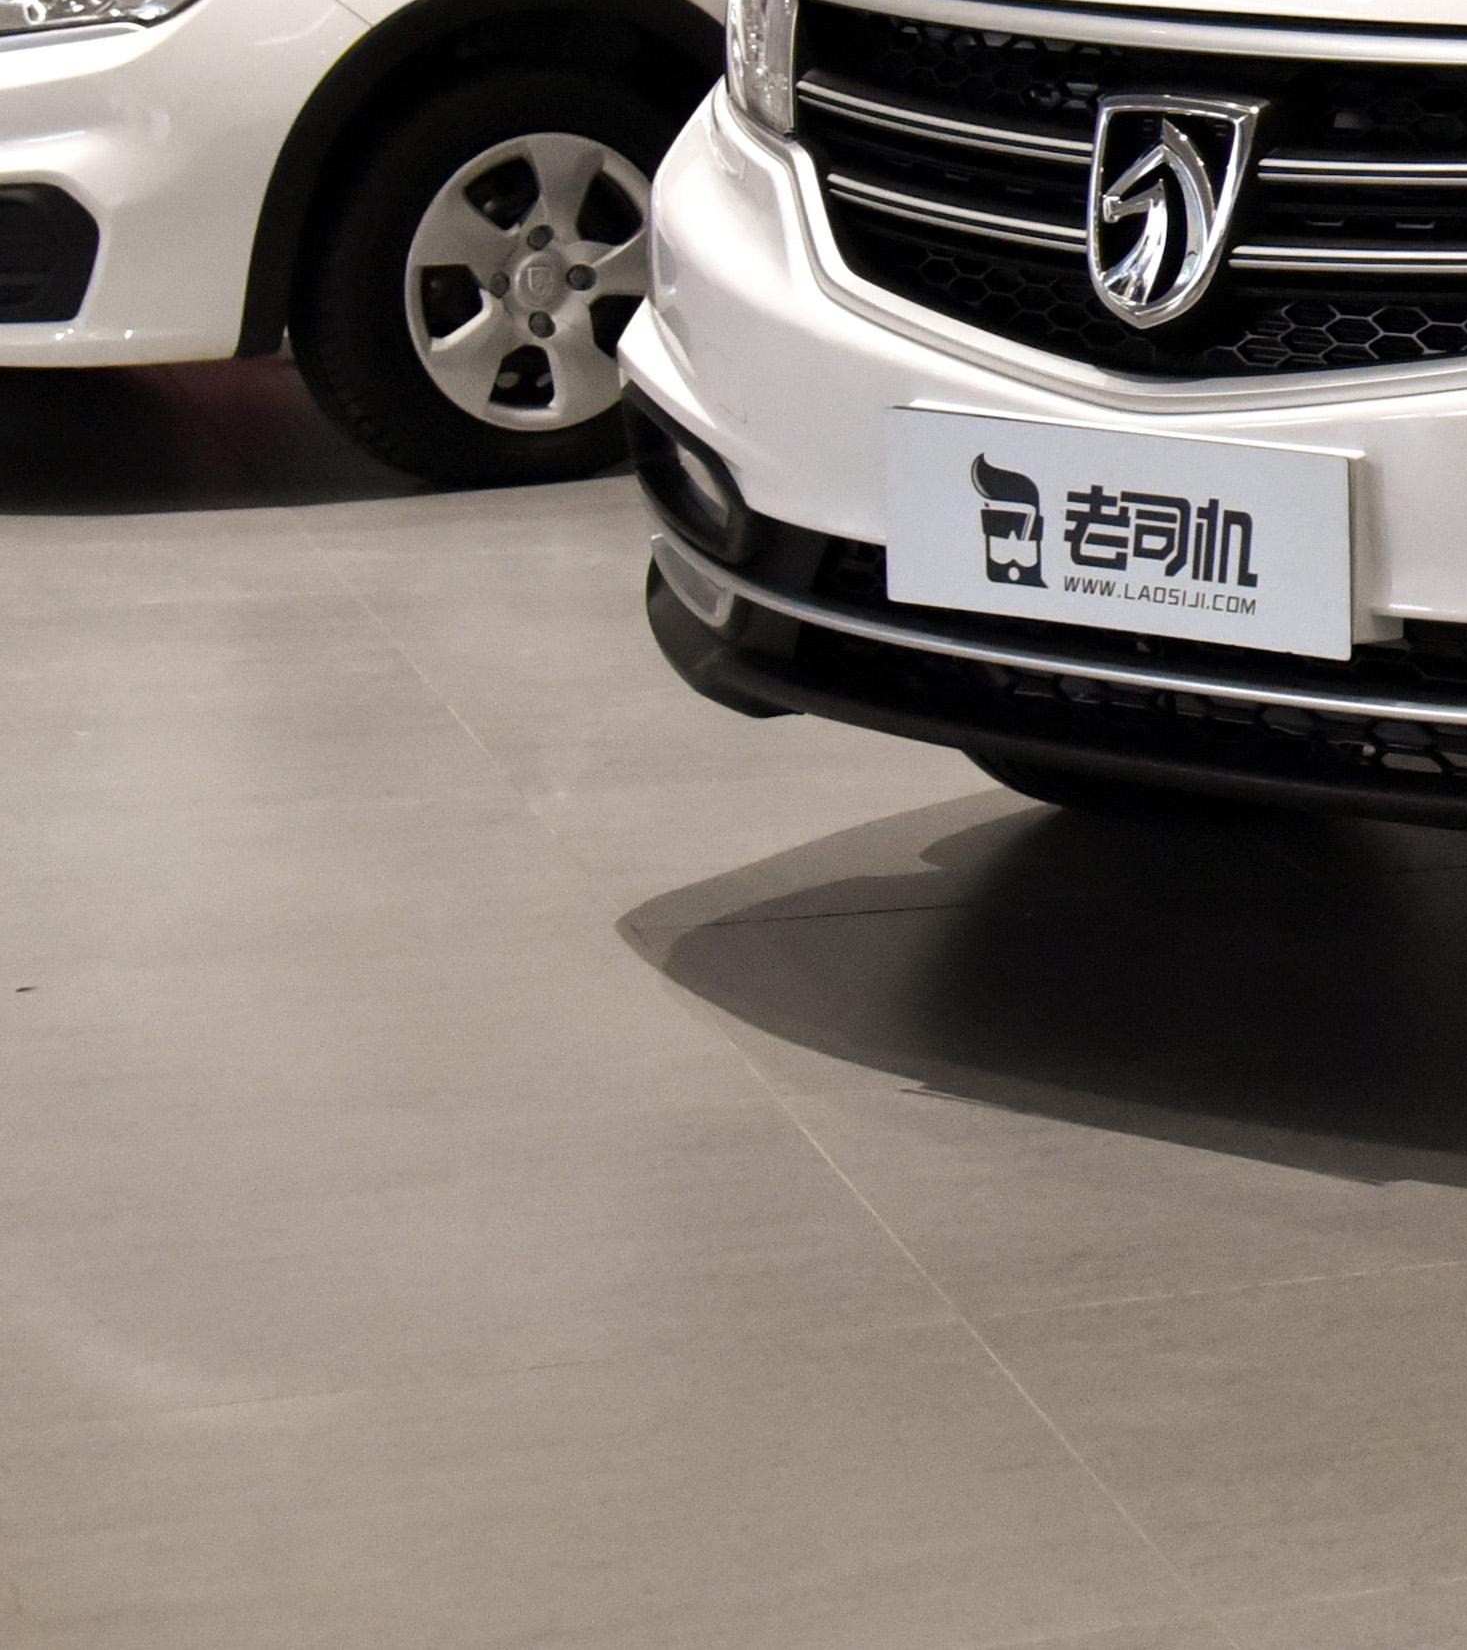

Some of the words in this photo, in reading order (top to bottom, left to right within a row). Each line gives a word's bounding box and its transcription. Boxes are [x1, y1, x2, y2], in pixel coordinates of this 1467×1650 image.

[1063, 485, 1258, 587] 老司机
[1064, 576, 1256, 615] WWW.LAOSIJI.COM
